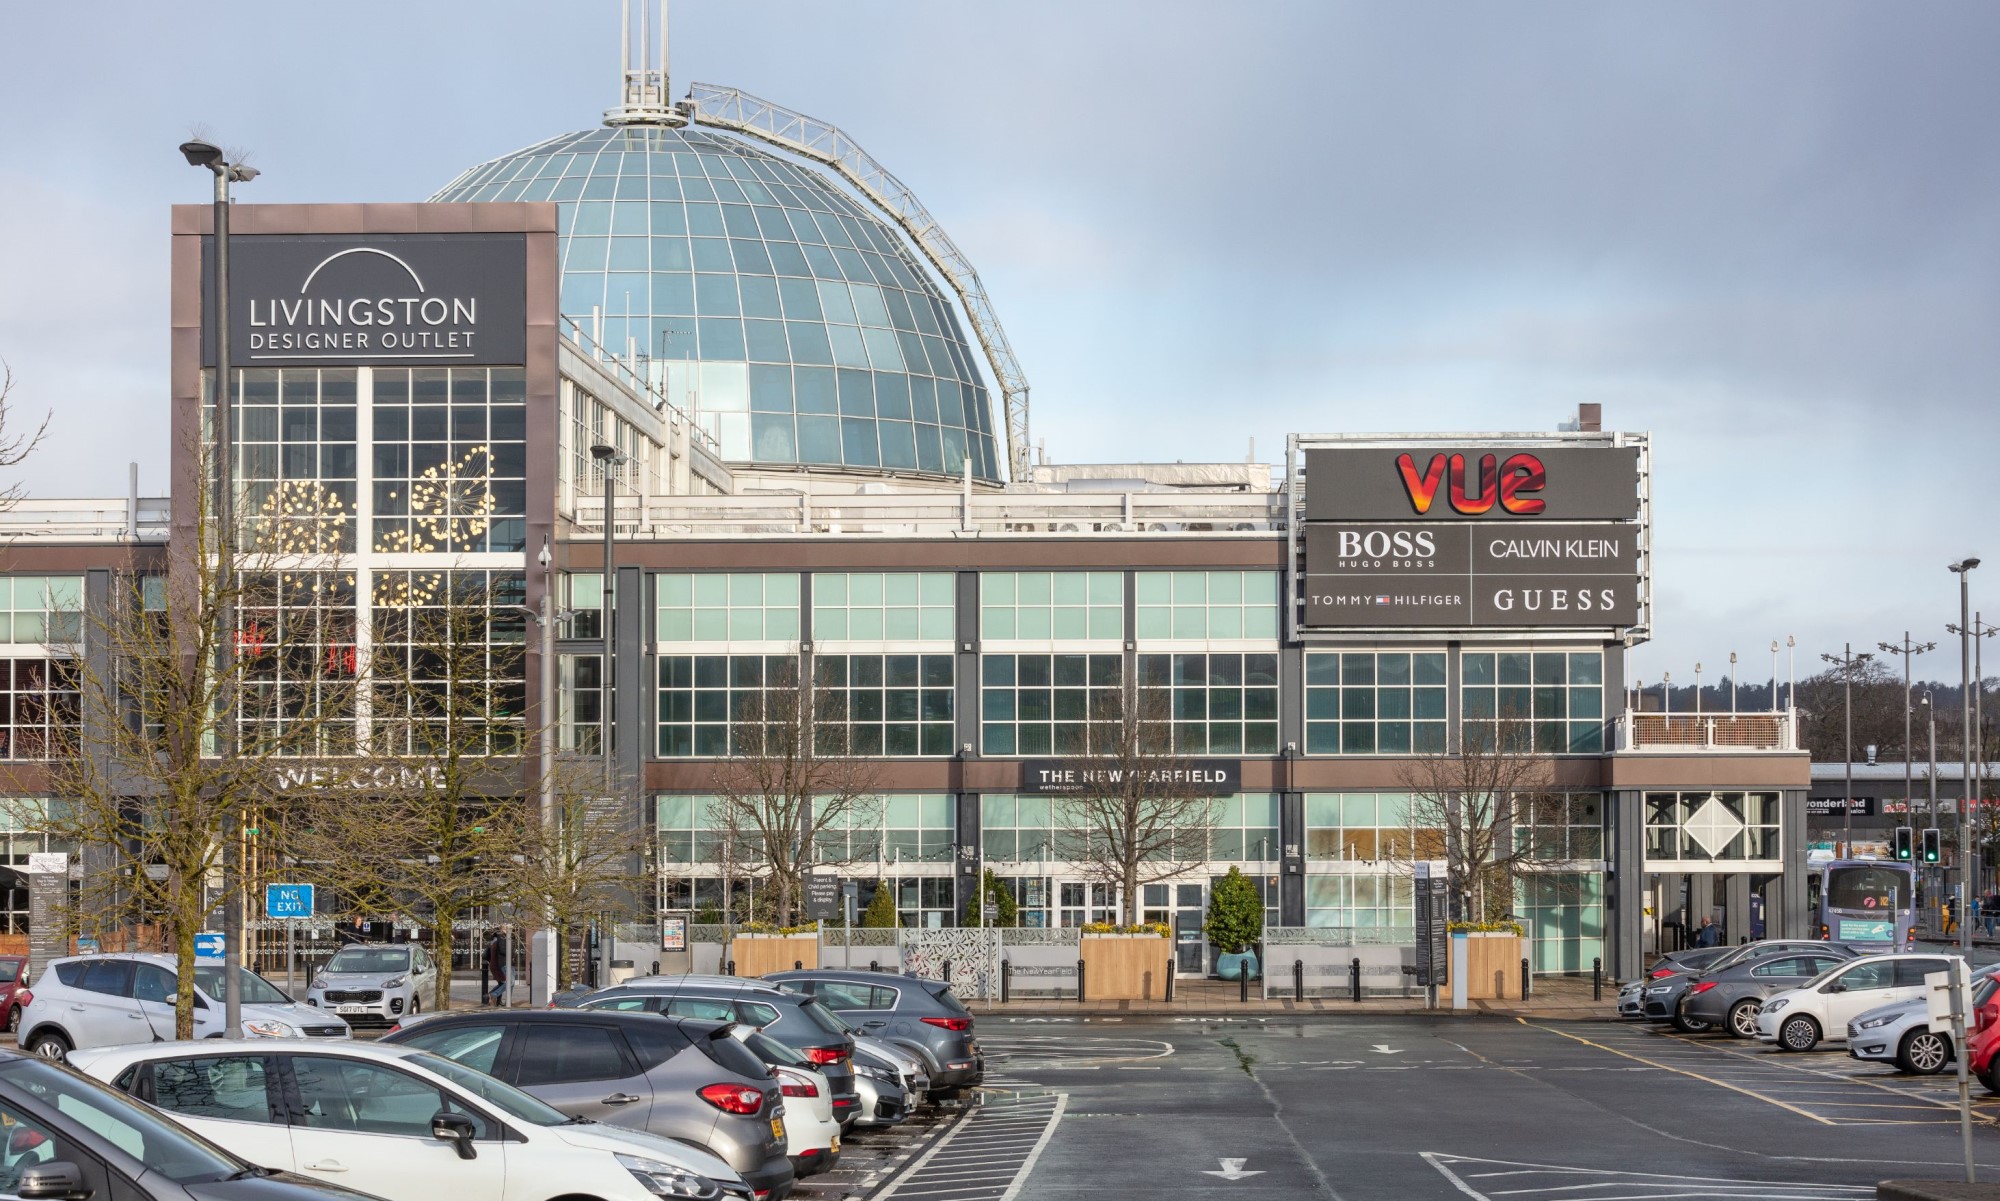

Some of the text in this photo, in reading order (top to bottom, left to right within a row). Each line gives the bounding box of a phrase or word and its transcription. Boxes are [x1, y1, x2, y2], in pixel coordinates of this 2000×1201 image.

[250, 298, 476, 327] LIVINGSTON
[250, 332, 475, 350] DESIGNER OUTLET
[1338, 531, 1436, 558] BOSS
[1489, 539, 1619, 559] CALVIN KLEIN
[1338, 560, 1435, 568] HUGO BOSS
[1312, 595, 1462, 606] TOMMY HILFIGER
[1493, 589, 1616, 611] GUESS
[275, 767, 447, 790] WELCOME
[1040, 770, 1075, 783] THE
[277, 902, 303, 911] EXIT
